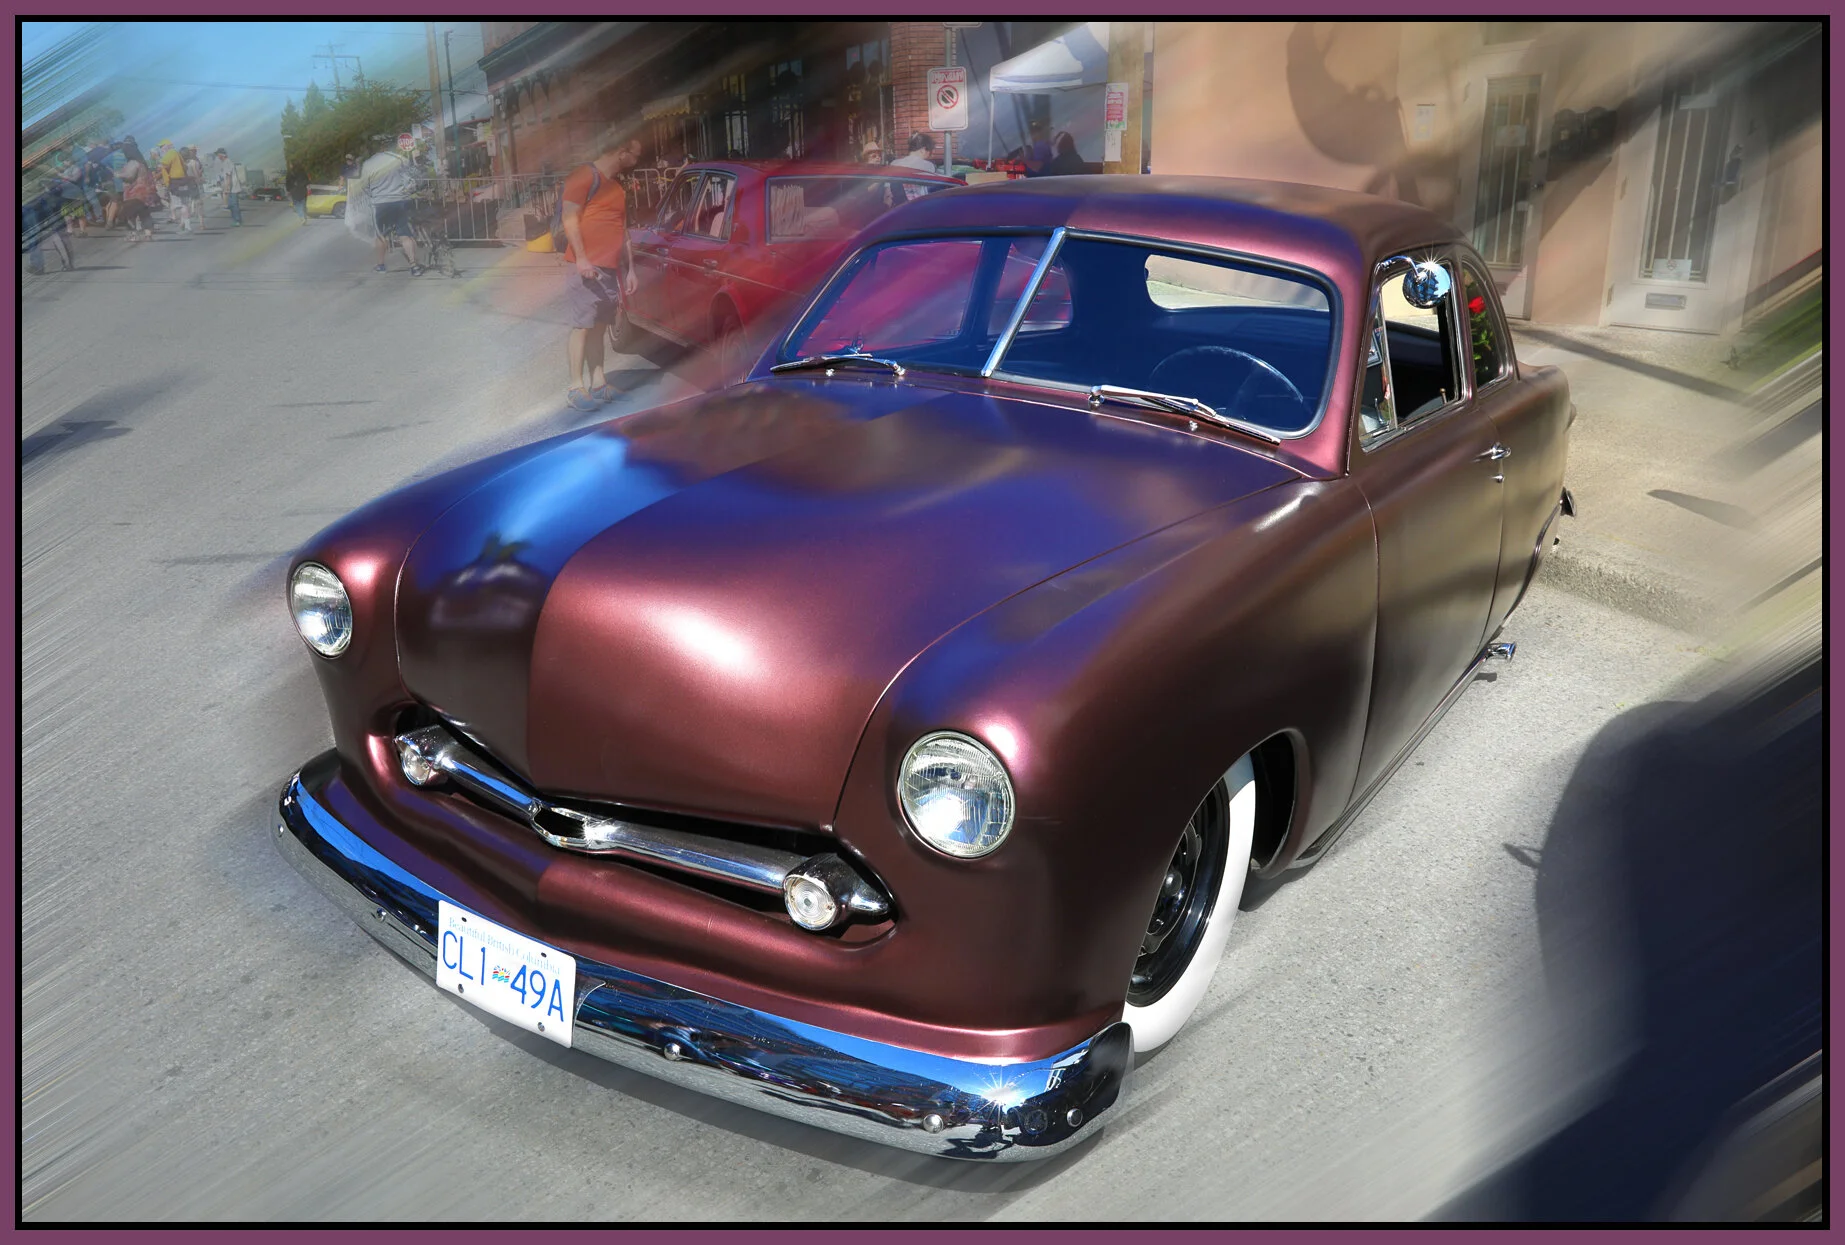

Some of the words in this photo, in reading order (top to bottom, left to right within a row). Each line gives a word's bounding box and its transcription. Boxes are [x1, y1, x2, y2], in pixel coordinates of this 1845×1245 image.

[449, 917, 486, 944] Beautiful
[487, 934, 515, 956] British
[515, 948, 560, 975] Columbia
